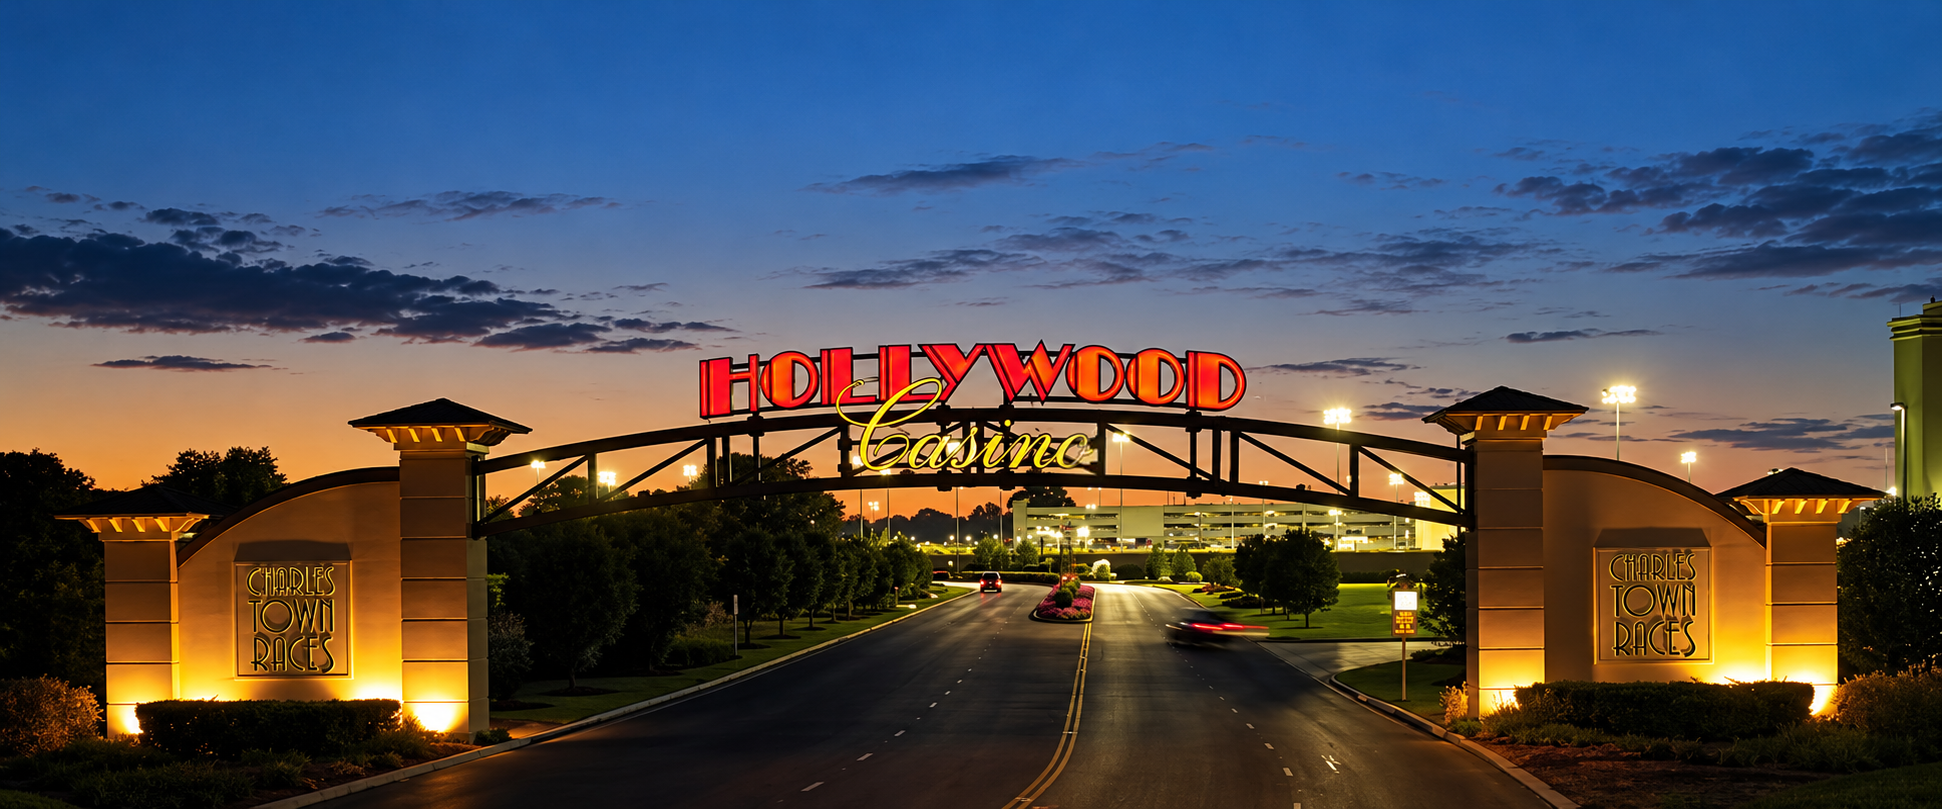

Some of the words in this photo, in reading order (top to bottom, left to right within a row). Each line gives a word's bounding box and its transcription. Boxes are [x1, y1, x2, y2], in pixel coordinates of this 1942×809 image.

[700, 340, 1246, 418] HOLLYWOOD
[836, 377, 1093, 470] Casino
[247, 567, 335, 596] CHARLES
[1609, 554, 1696, 581] CHARLES
[248, 599, 334, 633] TOWN
[1610, 584, 1696, 618] TOWN
[250, 636, 335, 673] RACES
[1612, 620, 1696, 657] RACES
